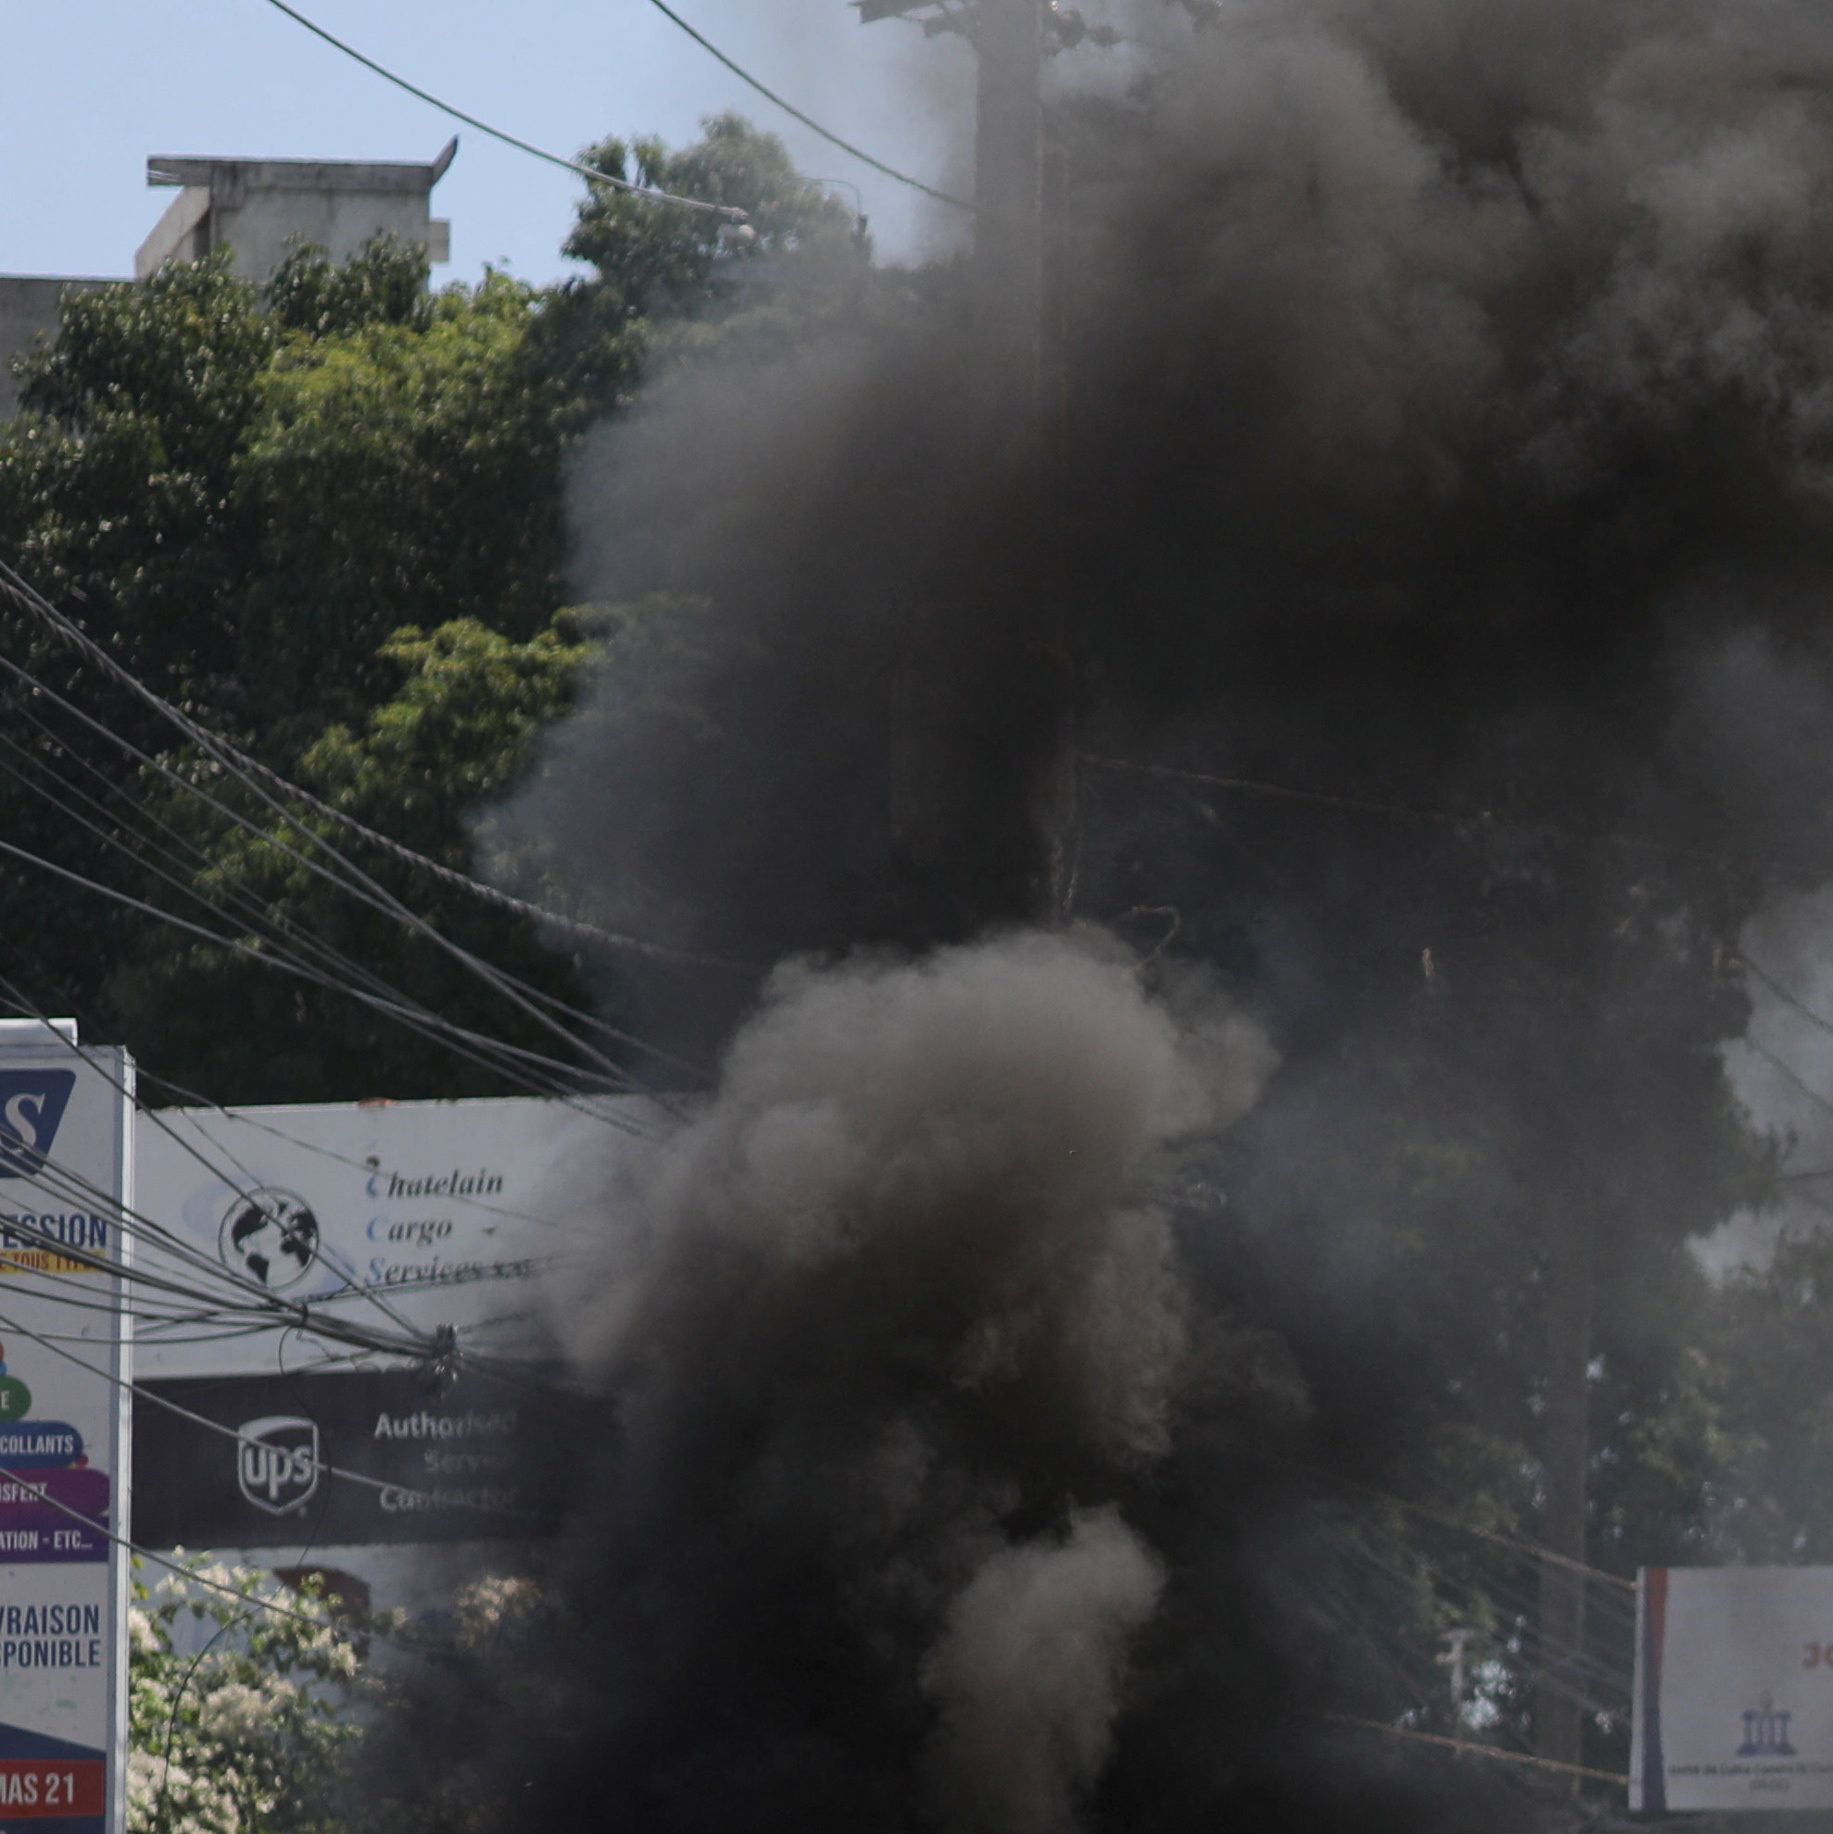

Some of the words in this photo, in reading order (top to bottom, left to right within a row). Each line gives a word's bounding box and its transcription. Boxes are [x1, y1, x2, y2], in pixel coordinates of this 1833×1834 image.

[366, 1167, 503, 1198] Chatelain
[366, 1215, 452, 1246] Cargo
[1, 1433, 74, 1455] COLLANTS
[246, 1446, 311, 1500] ups
[0, 1482, 48, 1504] SFERT
[4, 1639, 101, 1668] PONIBLE
[45, 1772, 75, 1805] 21
